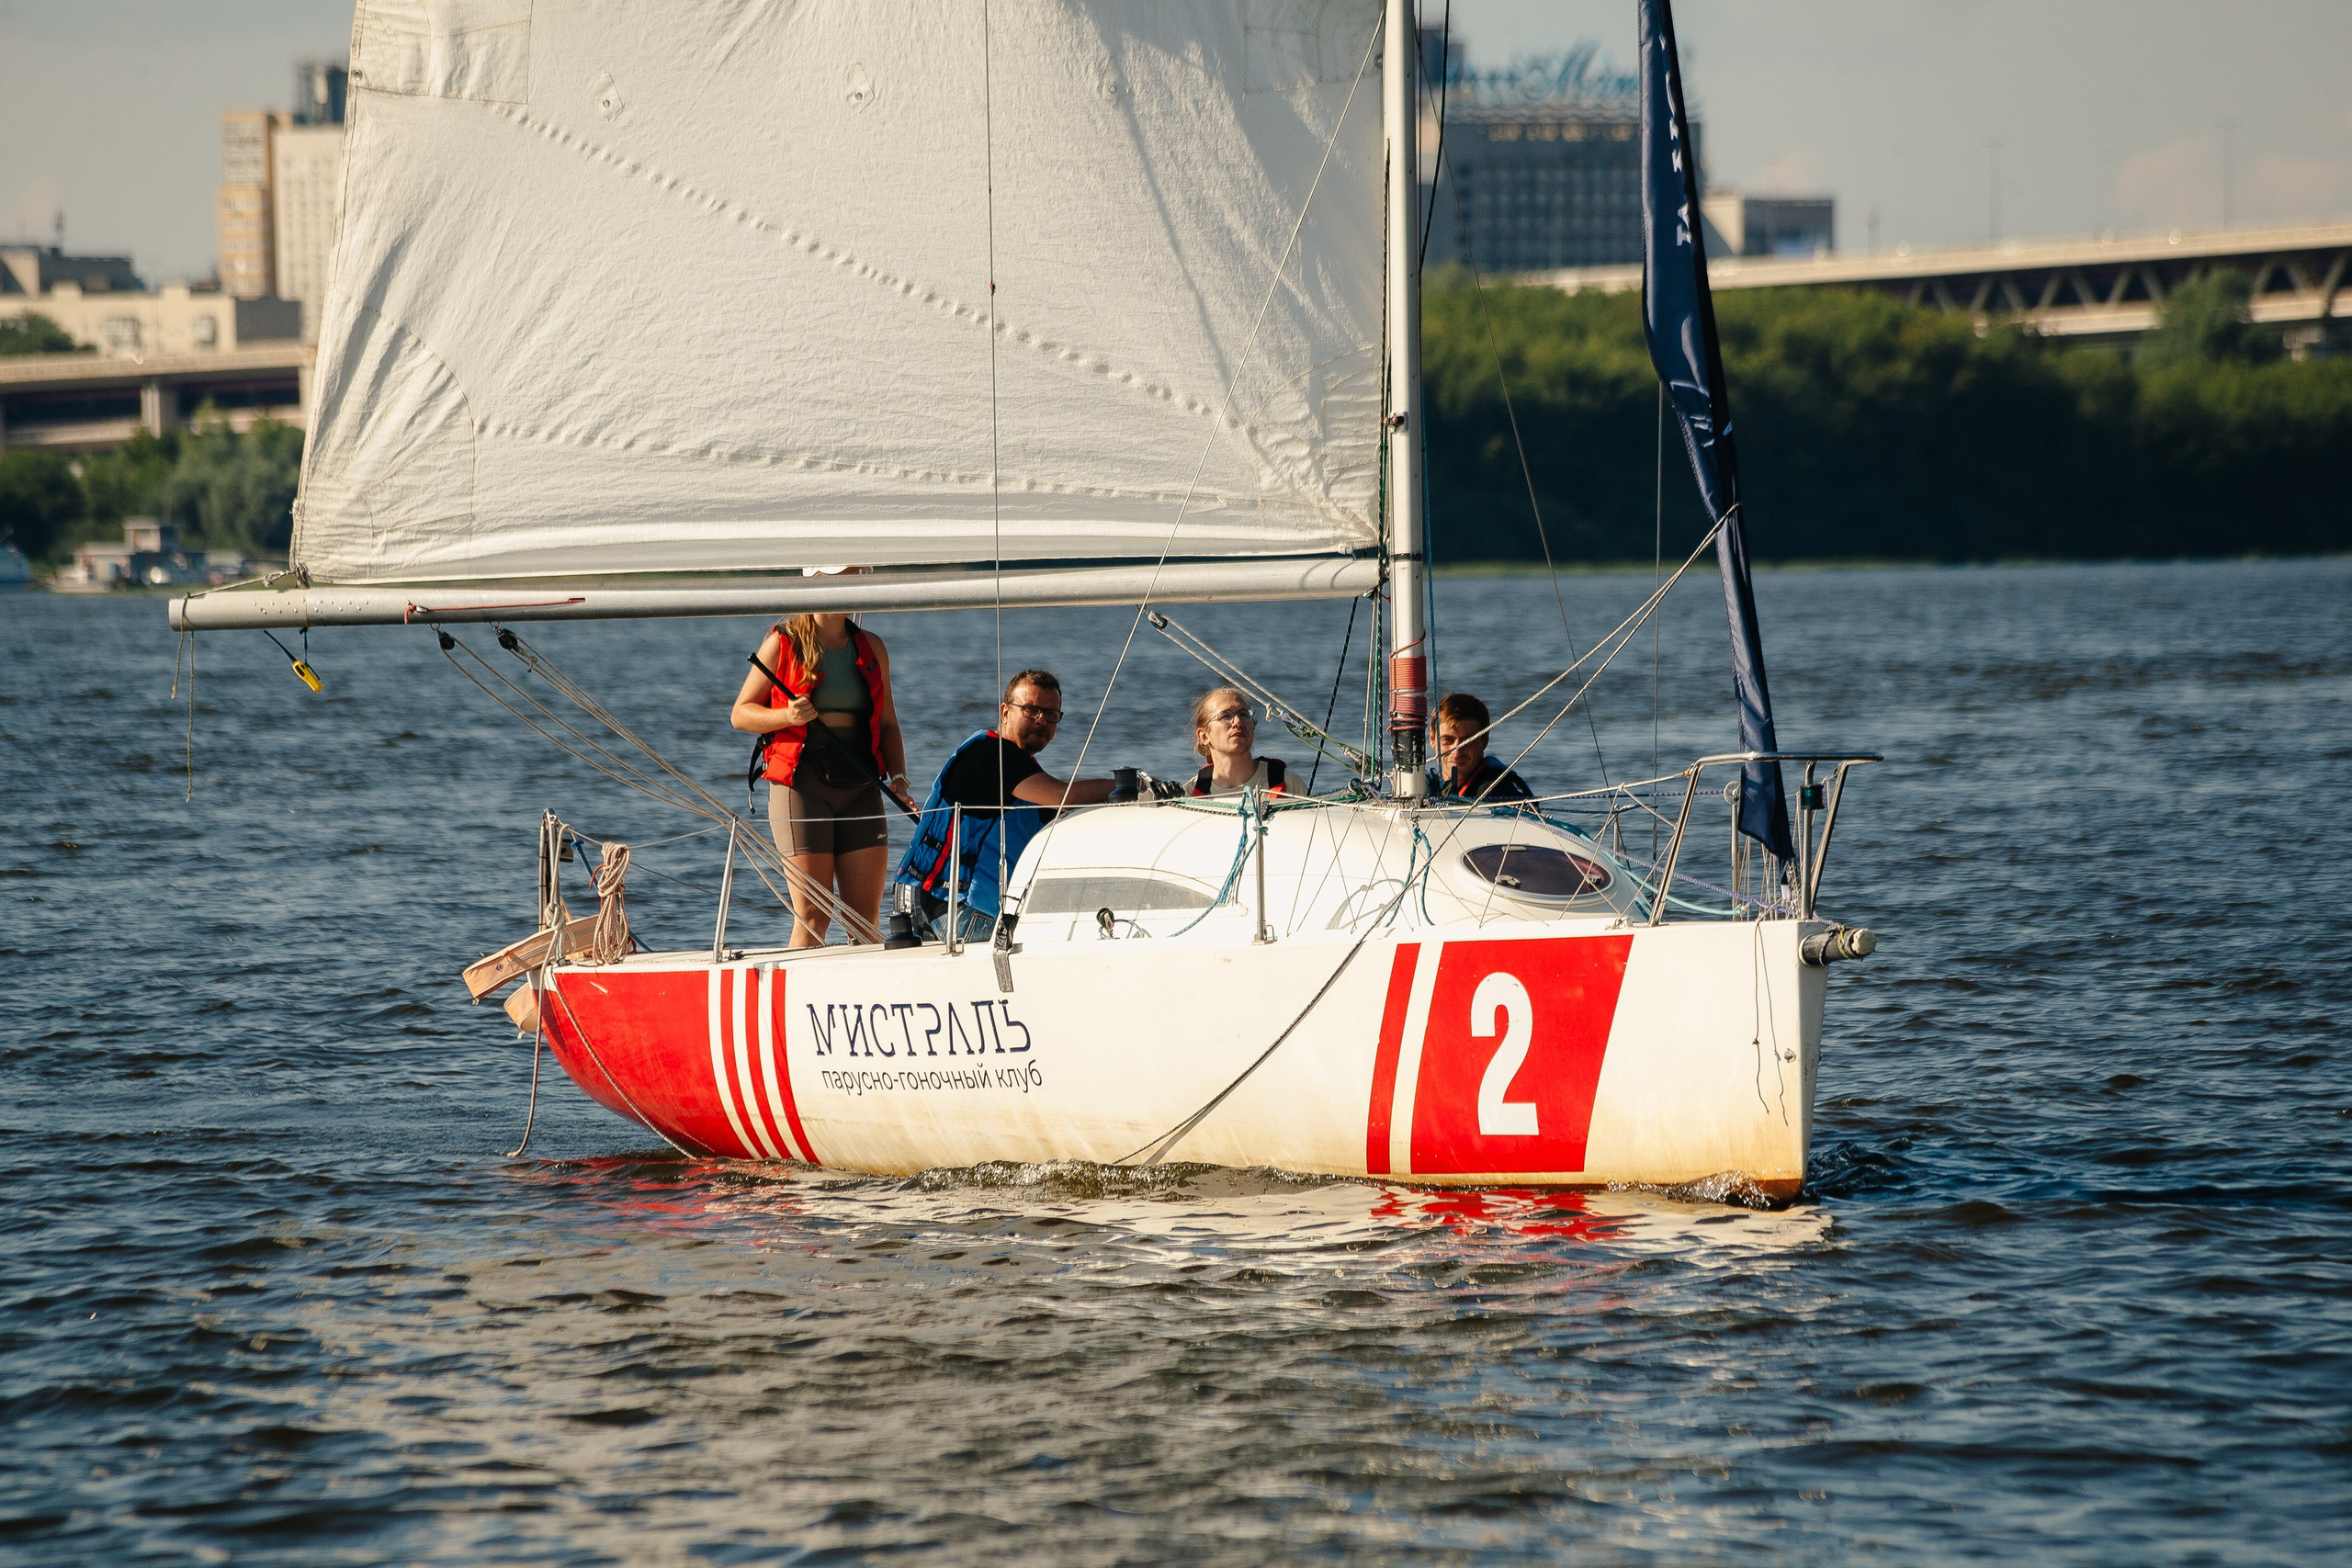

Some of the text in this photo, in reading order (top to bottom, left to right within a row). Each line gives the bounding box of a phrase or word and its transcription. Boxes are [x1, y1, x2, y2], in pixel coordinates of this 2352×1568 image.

[806, 998, 1031, 1057] МИСТРАЛЬ
[1470, 971, 1540, 1135] 2
[821, 1058, 1043, 1096] парусно-гоночный клуб
